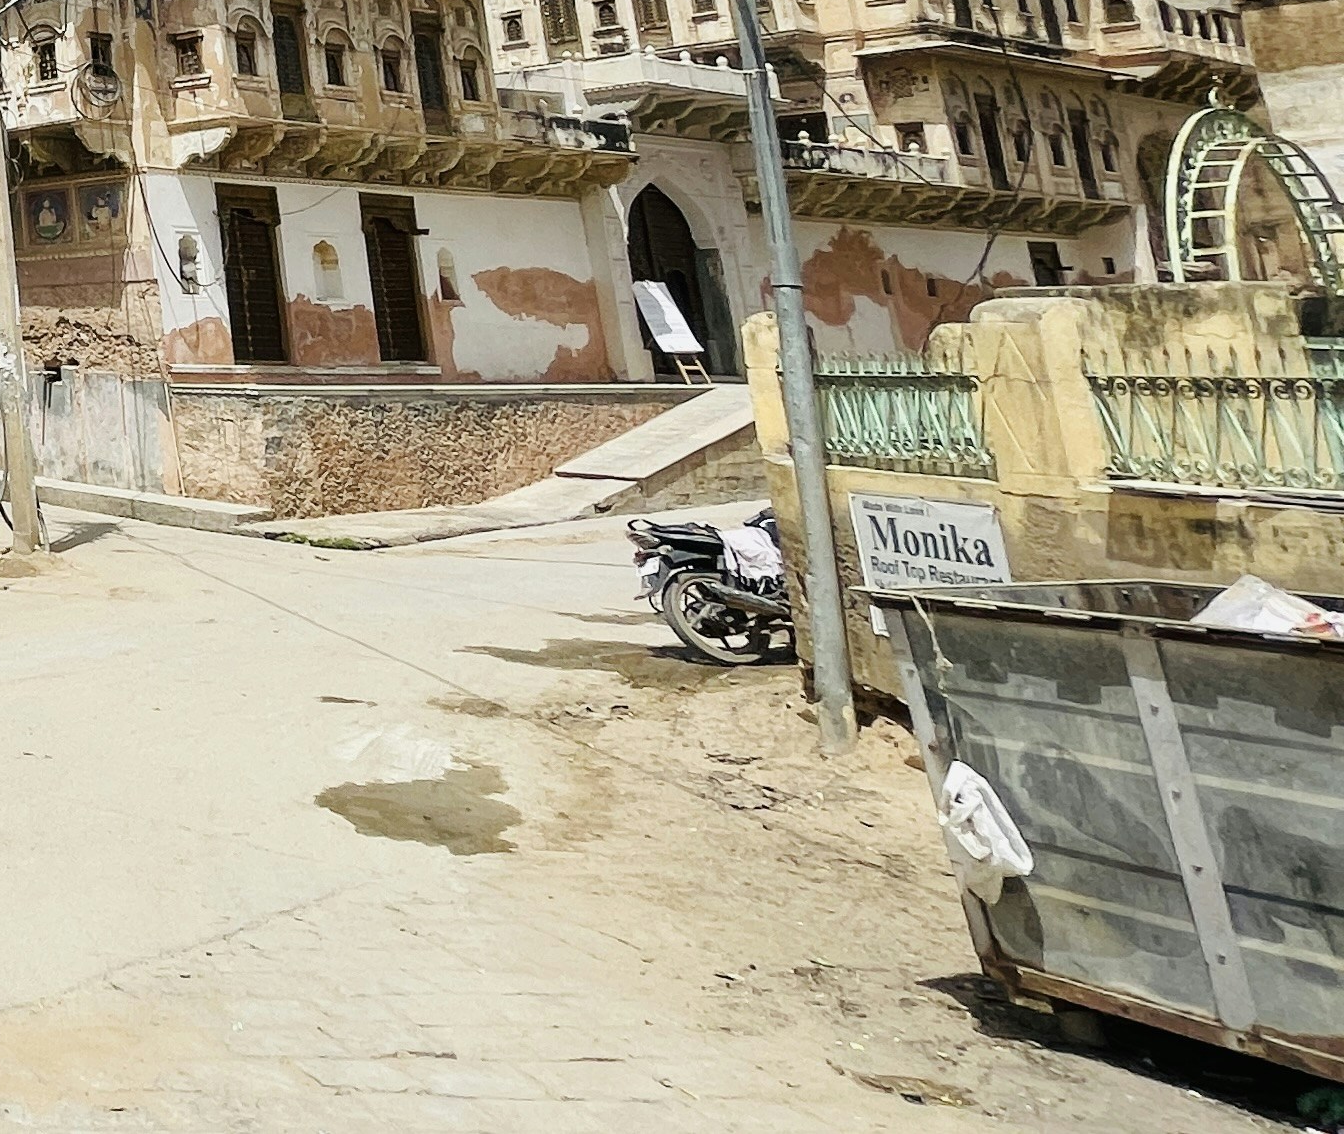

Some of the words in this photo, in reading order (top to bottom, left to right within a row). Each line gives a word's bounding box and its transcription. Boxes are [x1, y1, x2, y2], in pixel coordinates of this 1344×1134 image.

[867, 515, 995, 567] Monika
[870, 556, 900, 575] Roof
[901, 560, 926, 584] Top
